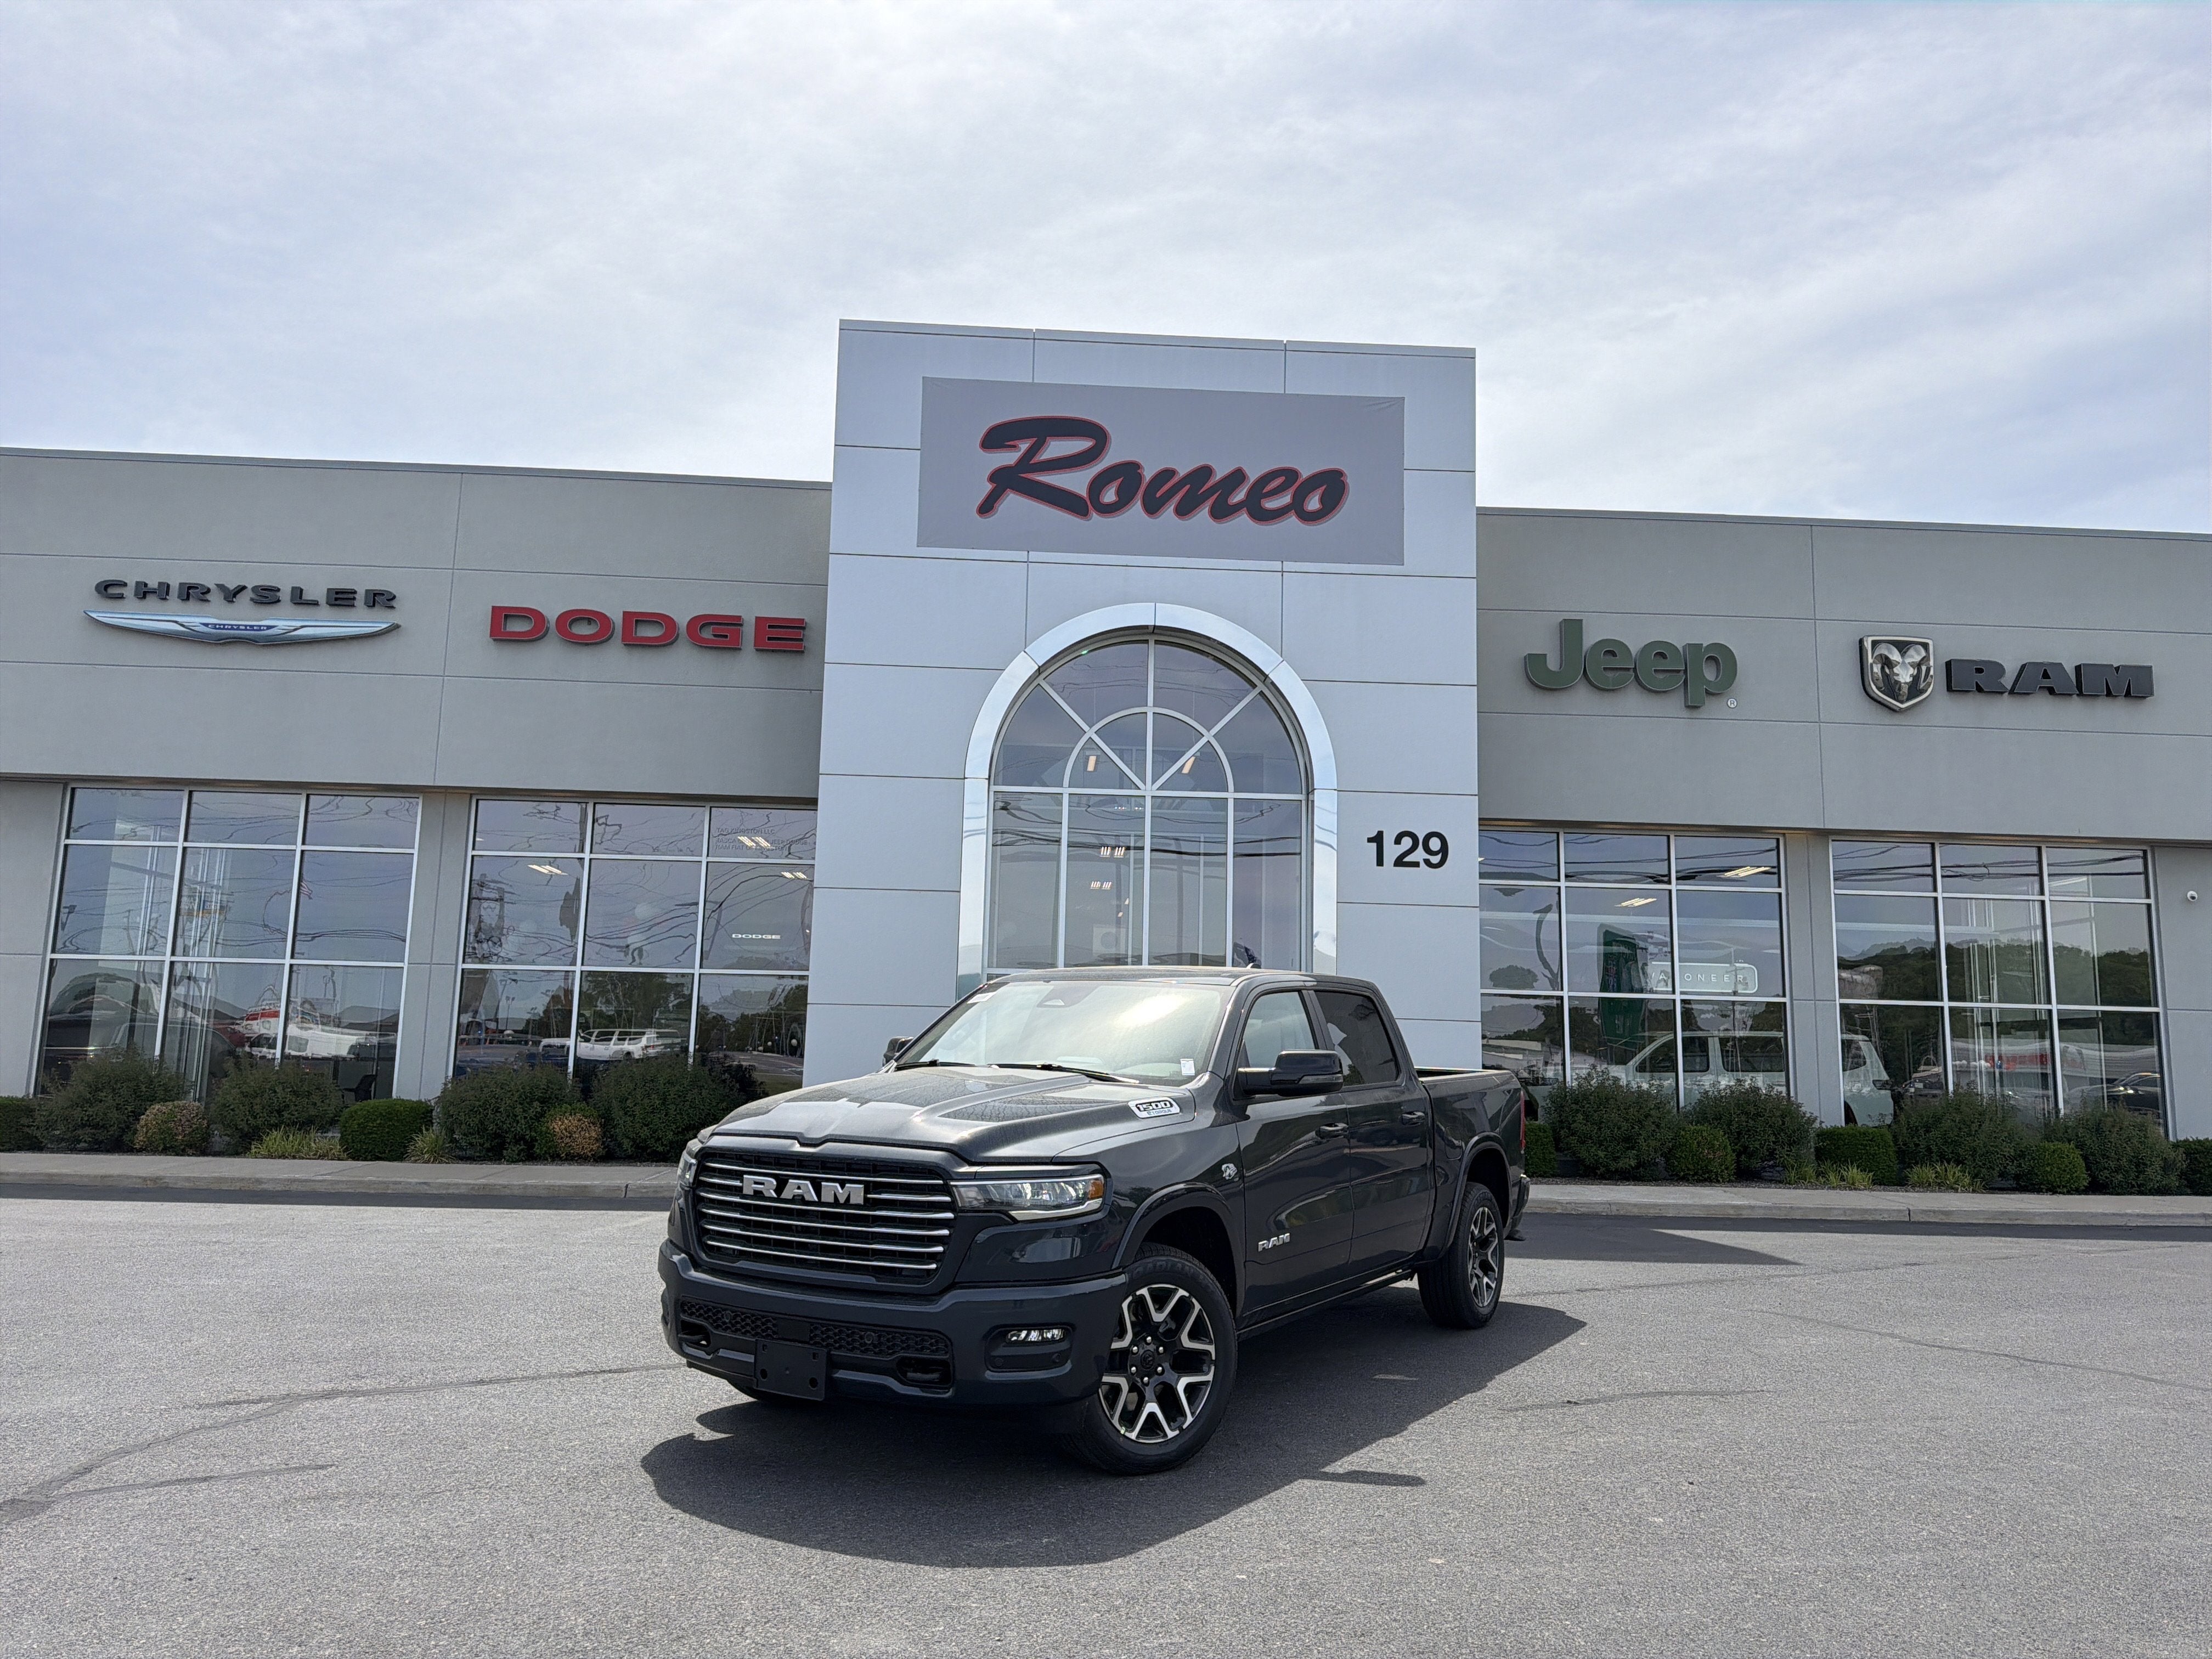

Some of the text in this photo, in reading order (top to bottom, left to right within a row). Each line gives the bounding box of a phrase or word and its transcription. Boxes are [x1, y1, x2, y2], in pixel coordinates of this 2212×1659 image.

[976, 415, 1349, 525] Romeo
[94, 579, 397, 609] CHRYSLER
[489, 605, 806, 652] DODGE
[1524, 618, 1738, 708] Jeep
[1945, 658, 2154, 699] RAM
[1367, 830, 1449, 869] 129
[1651, 972, 1743, 983] AONEER
[1137, 1101, 1171, 1111] 1500
[743, 1175, 865, 1205] RAM
[1257, 1233, 1290, 1252] RAM
